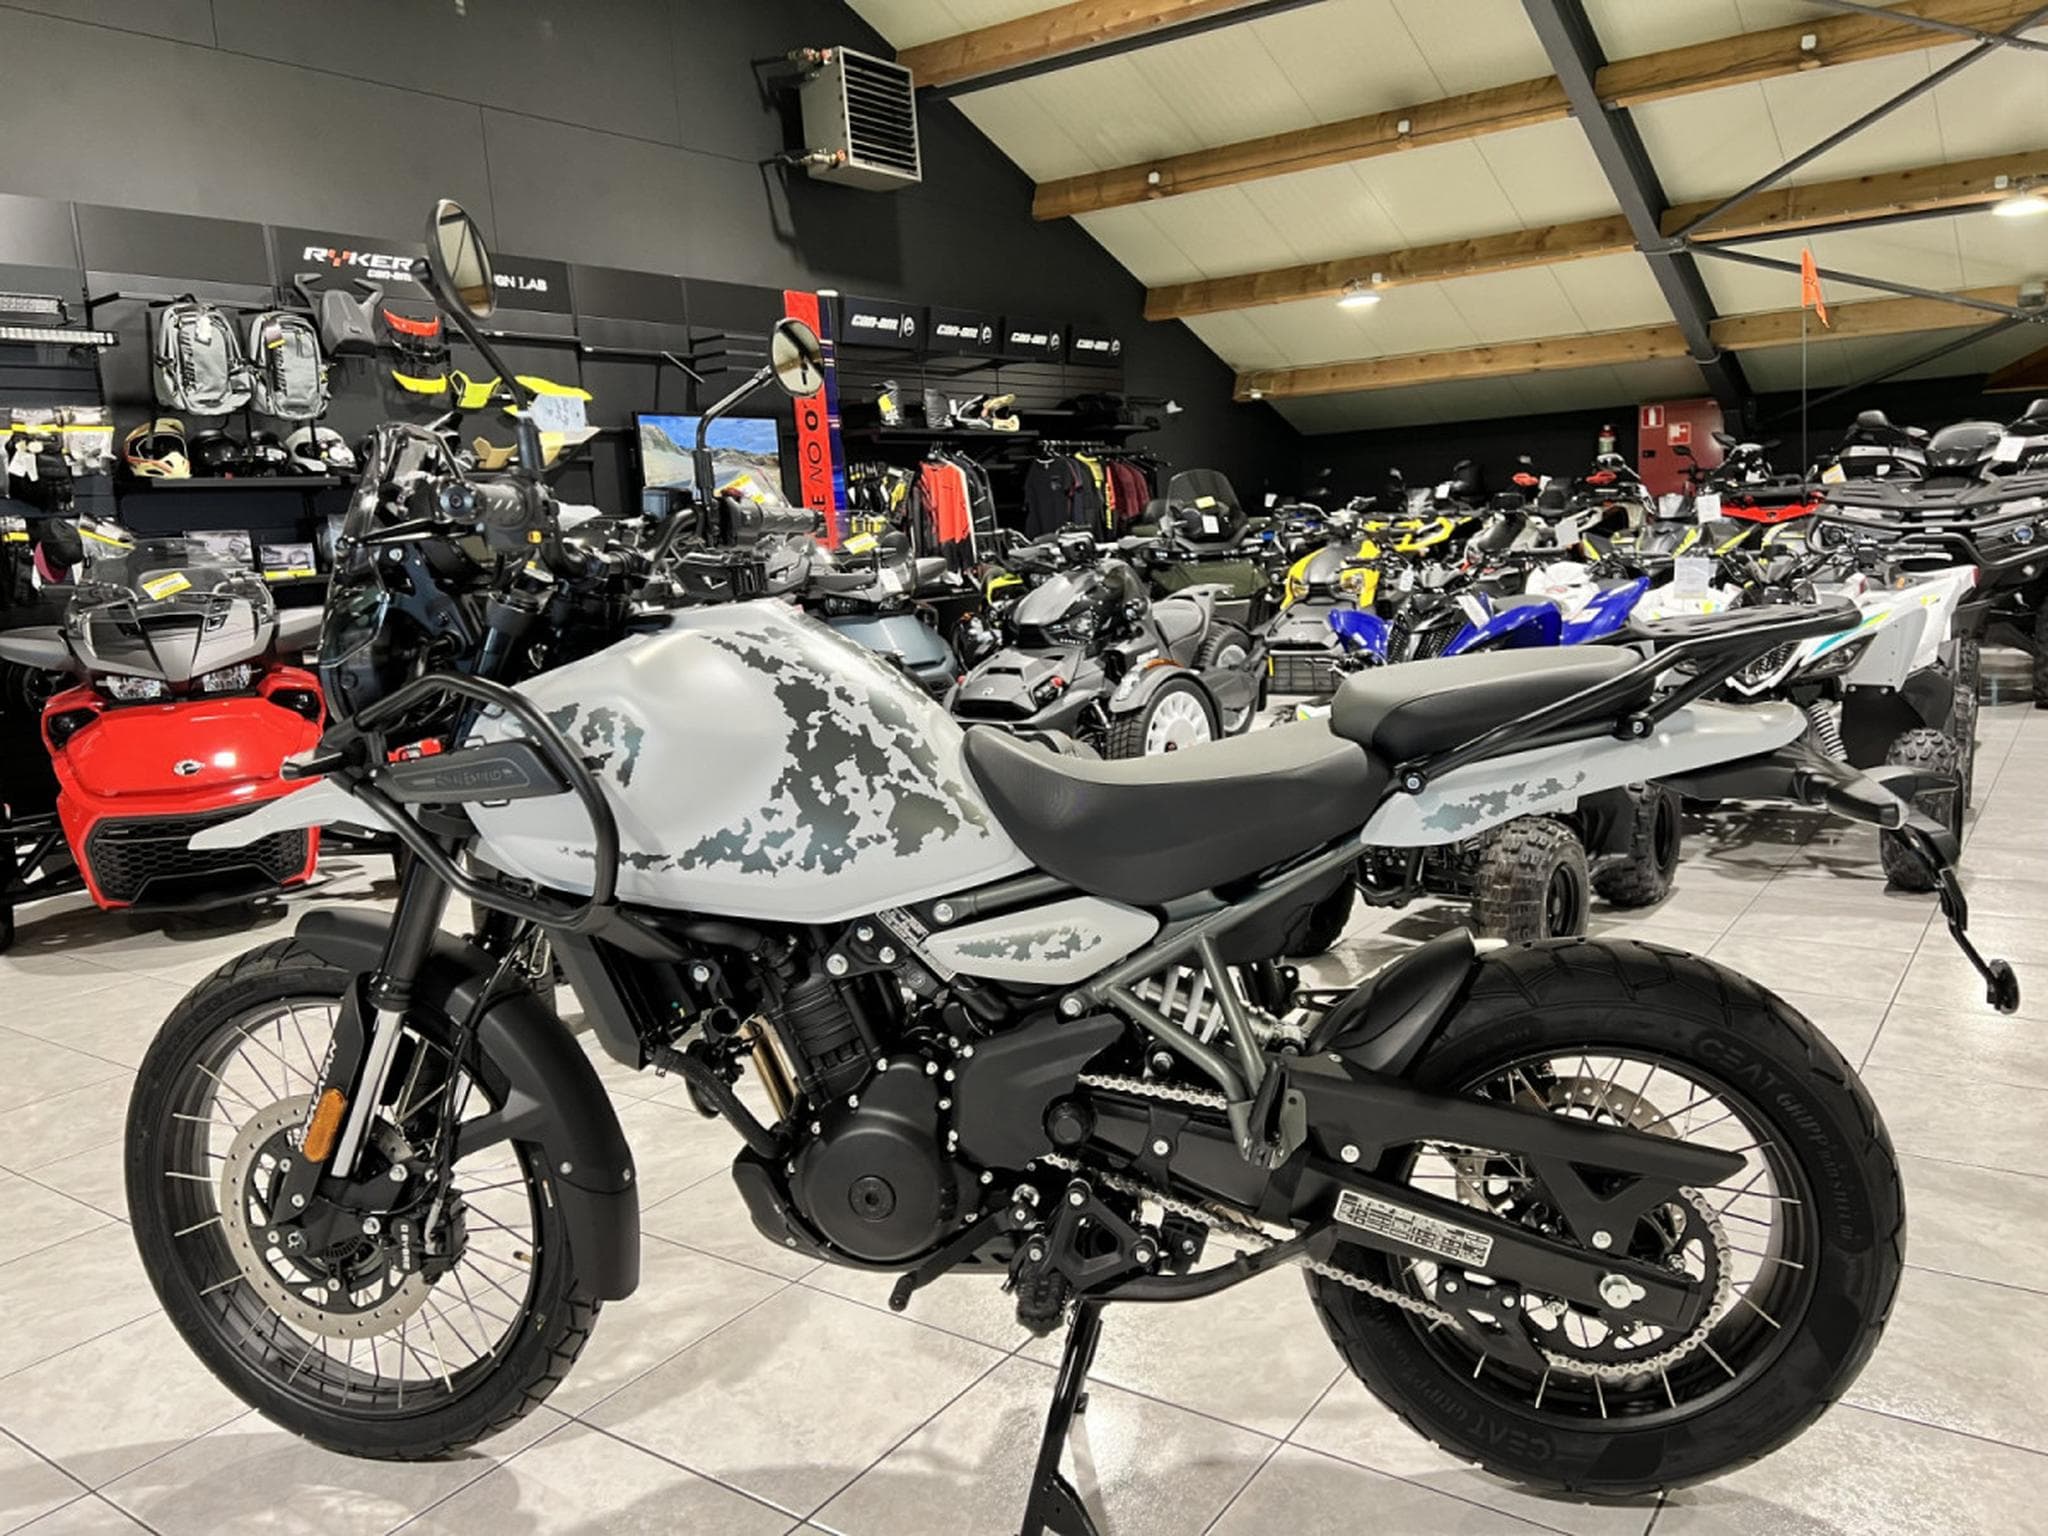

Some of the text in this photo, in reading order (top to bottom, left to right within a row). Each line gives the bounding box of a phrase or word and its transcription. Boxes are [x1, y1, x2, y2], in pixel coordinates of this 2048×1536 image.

[303, 246, 414, 271] RYKER
[518, 276, 547, 292] LAB
[1698, 1037, 1783, 1092] CEAT
[1467, 1414, 1551, 1460] CEAT
